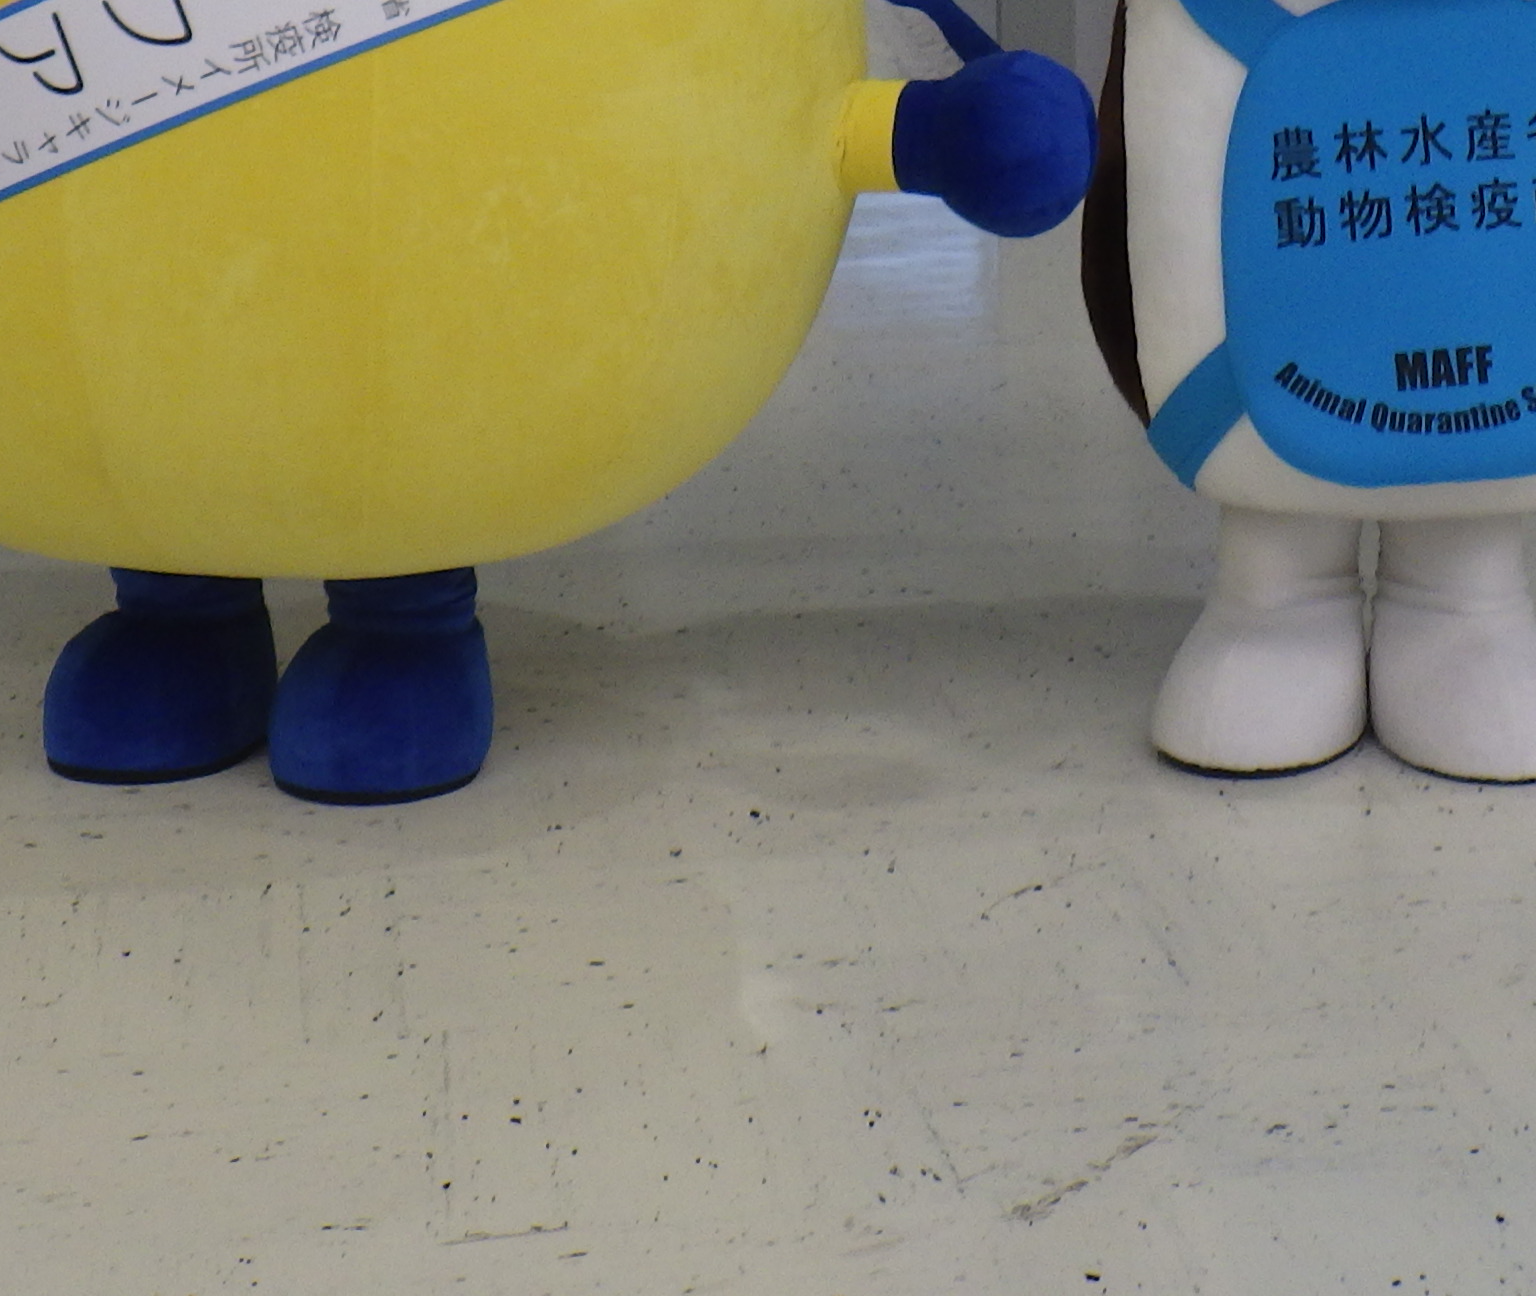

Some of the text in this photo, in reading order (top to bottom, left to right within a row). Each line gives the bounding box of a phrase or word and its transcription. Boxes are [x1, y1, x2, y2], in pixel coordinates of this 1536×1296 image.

[1273, 360, 1368, 425] Animal
[1370, 399, 1522, 435] Quarantine
[1393, 344, 1494, 392] MAFF
